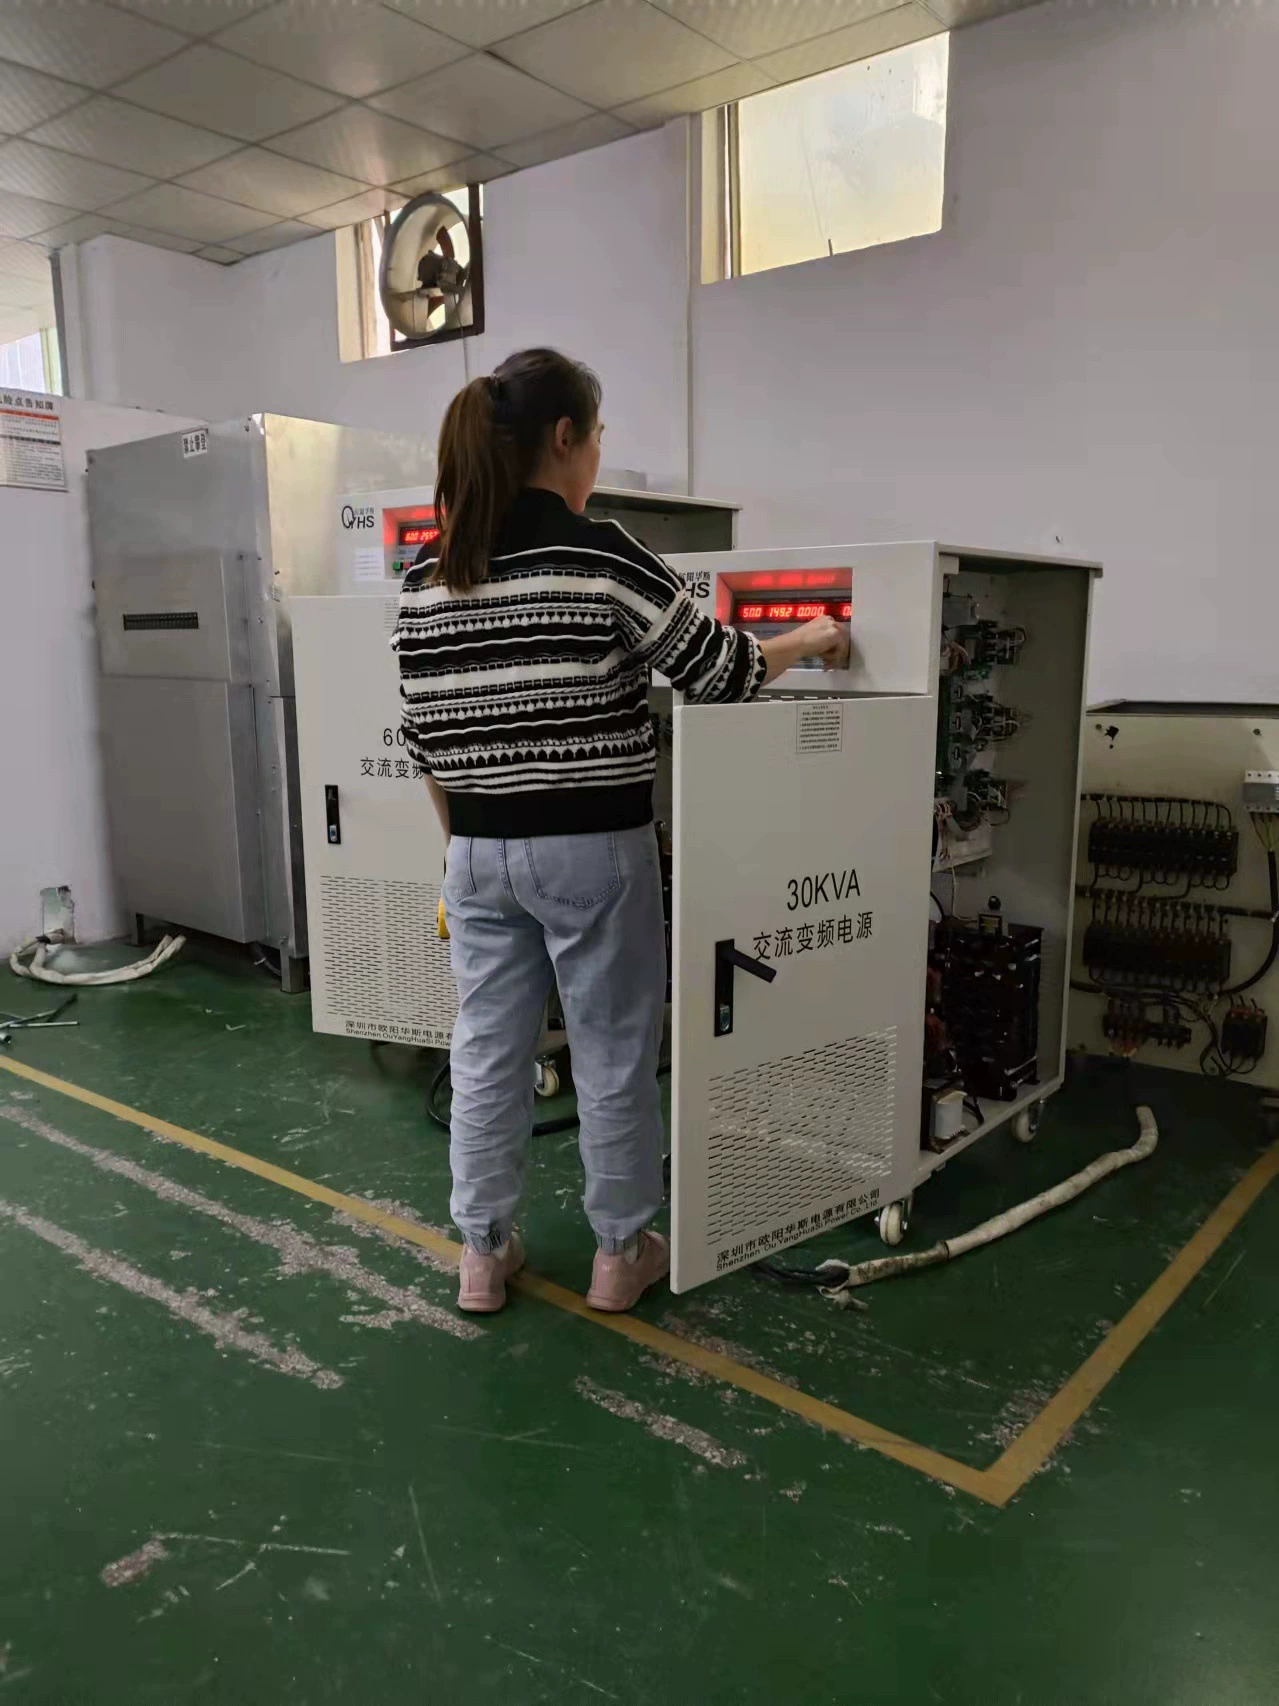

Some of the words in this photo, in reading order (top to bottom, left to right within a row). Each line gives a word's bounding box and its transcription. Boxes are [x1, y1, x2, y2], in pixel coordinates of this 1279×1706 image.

[787, 868, 861, 911] 30KVA
[753, 911, 873, 961] 交流变频电源
[716, 1188, 880, 1263] 深圳市欧阳华斯电源有限公司
